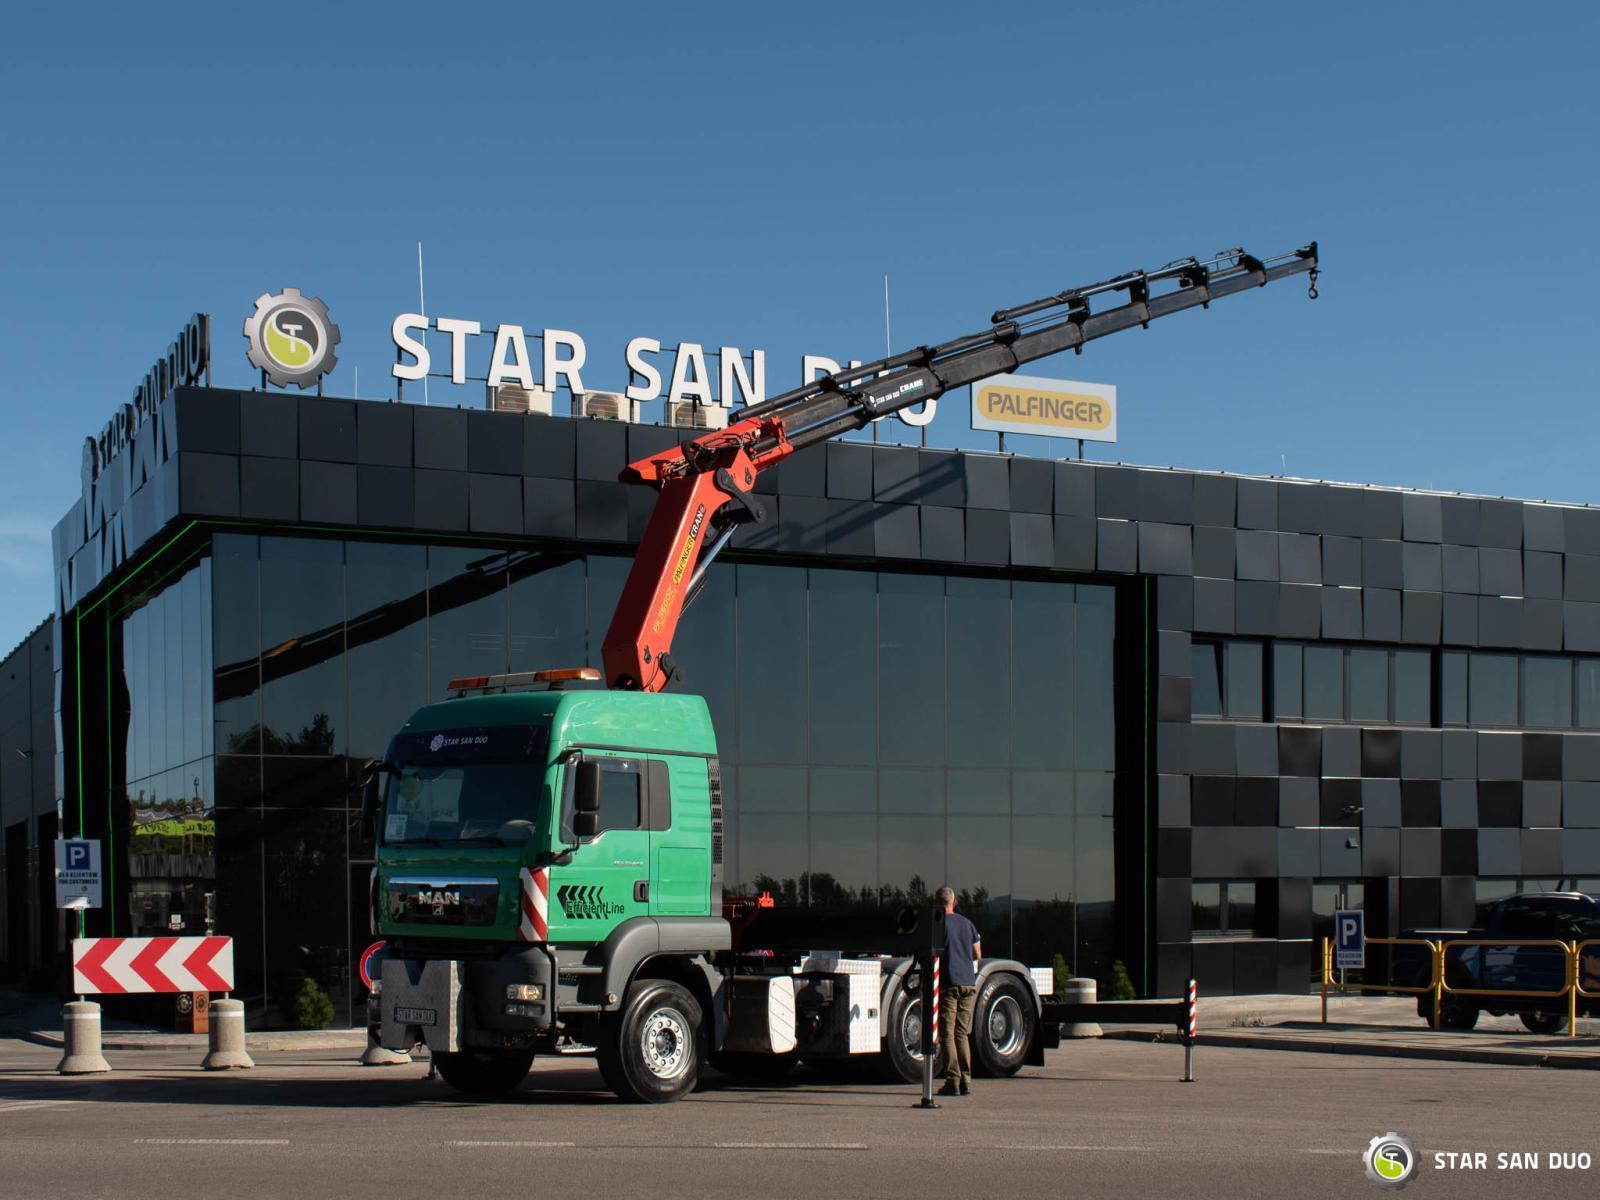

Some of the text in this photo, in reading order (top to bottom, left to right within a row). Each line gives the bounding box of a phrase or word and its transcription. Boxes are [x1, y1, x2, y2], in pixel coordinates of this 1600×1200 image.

[167, 312, 206, 391] DUO
[392, 313, 586, 395] STAR
[625, 337, 766, 408] SAN
[987, 391, 1103, 424] PALFINGER
[70, 846, 86, 867] P
[418, 891, 461, 905] MAN
[566, 901, 625, 914] EfficientLine
[1342, 919, 1358, 945] P
